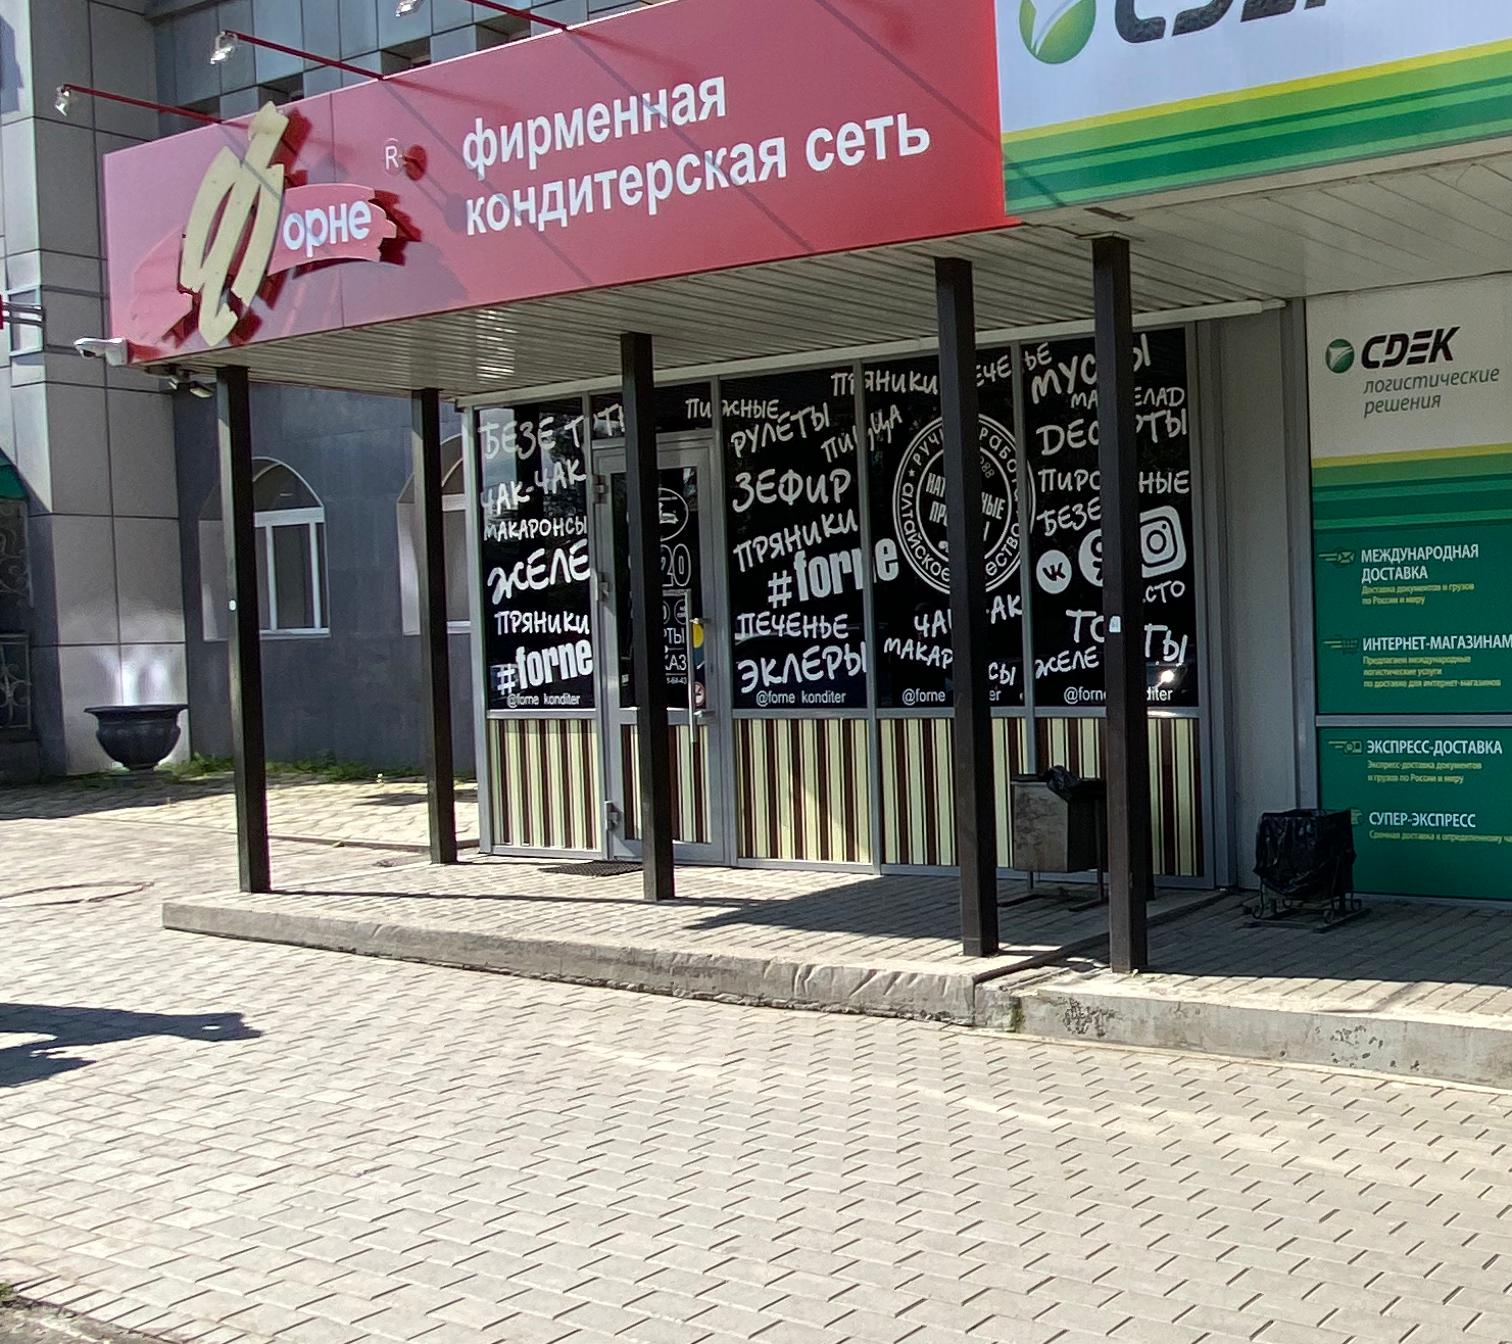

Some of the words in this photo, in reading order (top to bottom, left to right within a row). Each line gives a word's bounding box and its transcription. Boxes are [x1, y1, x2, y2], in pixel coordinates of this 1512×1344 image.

[462, 75, 726, 178] фирменная
[465, 132, 787, 237] кондитерская
[804, 113, 931, 174] сеть
[1361, 327, 1461, 369] CDEK
[1363, 368, 1500, 395] логистические
[1364, 394, 1441, 418] решения
[477, 417, 556, 460] БЕЗЕ
[731, 403, 829, 458] РУЛЕТЫ
[481, 458, 587, 515] ЧАК-ЧАК
[733, 468, 851, 512] ЗЕФИР
[483, 516, 587, 542] МАКАРОНСЫ
[1037, 496, 1101, 536] БЕЗЕ
[733, 509, 858, 572] ПРЯНИКИ
[1361, 543, 1479, 564] МЕЖДУНАРОДНАЯ
[487, 538, 591, 605] ЖЕЛЕ
[1361, 565, 1429, 584] ДОСТАВКА
[494, 610, 590, 636] ПРЯНИКИ
[736, 612, 849, 640] ПЕЧЕНЬЕ
[496, 639, 593, 696] #forne
[738, 641, 867, 694] ЭКЛЕРЫ
[1035, 646, 1100, 680] ЖЕЛЕ
[1366, 740, 1503, 756] ЭКСПРЕСС-ДОСТАВКА
[1368, 811, 1476, 828] СУПЕР-ЭКСПРЕСС
